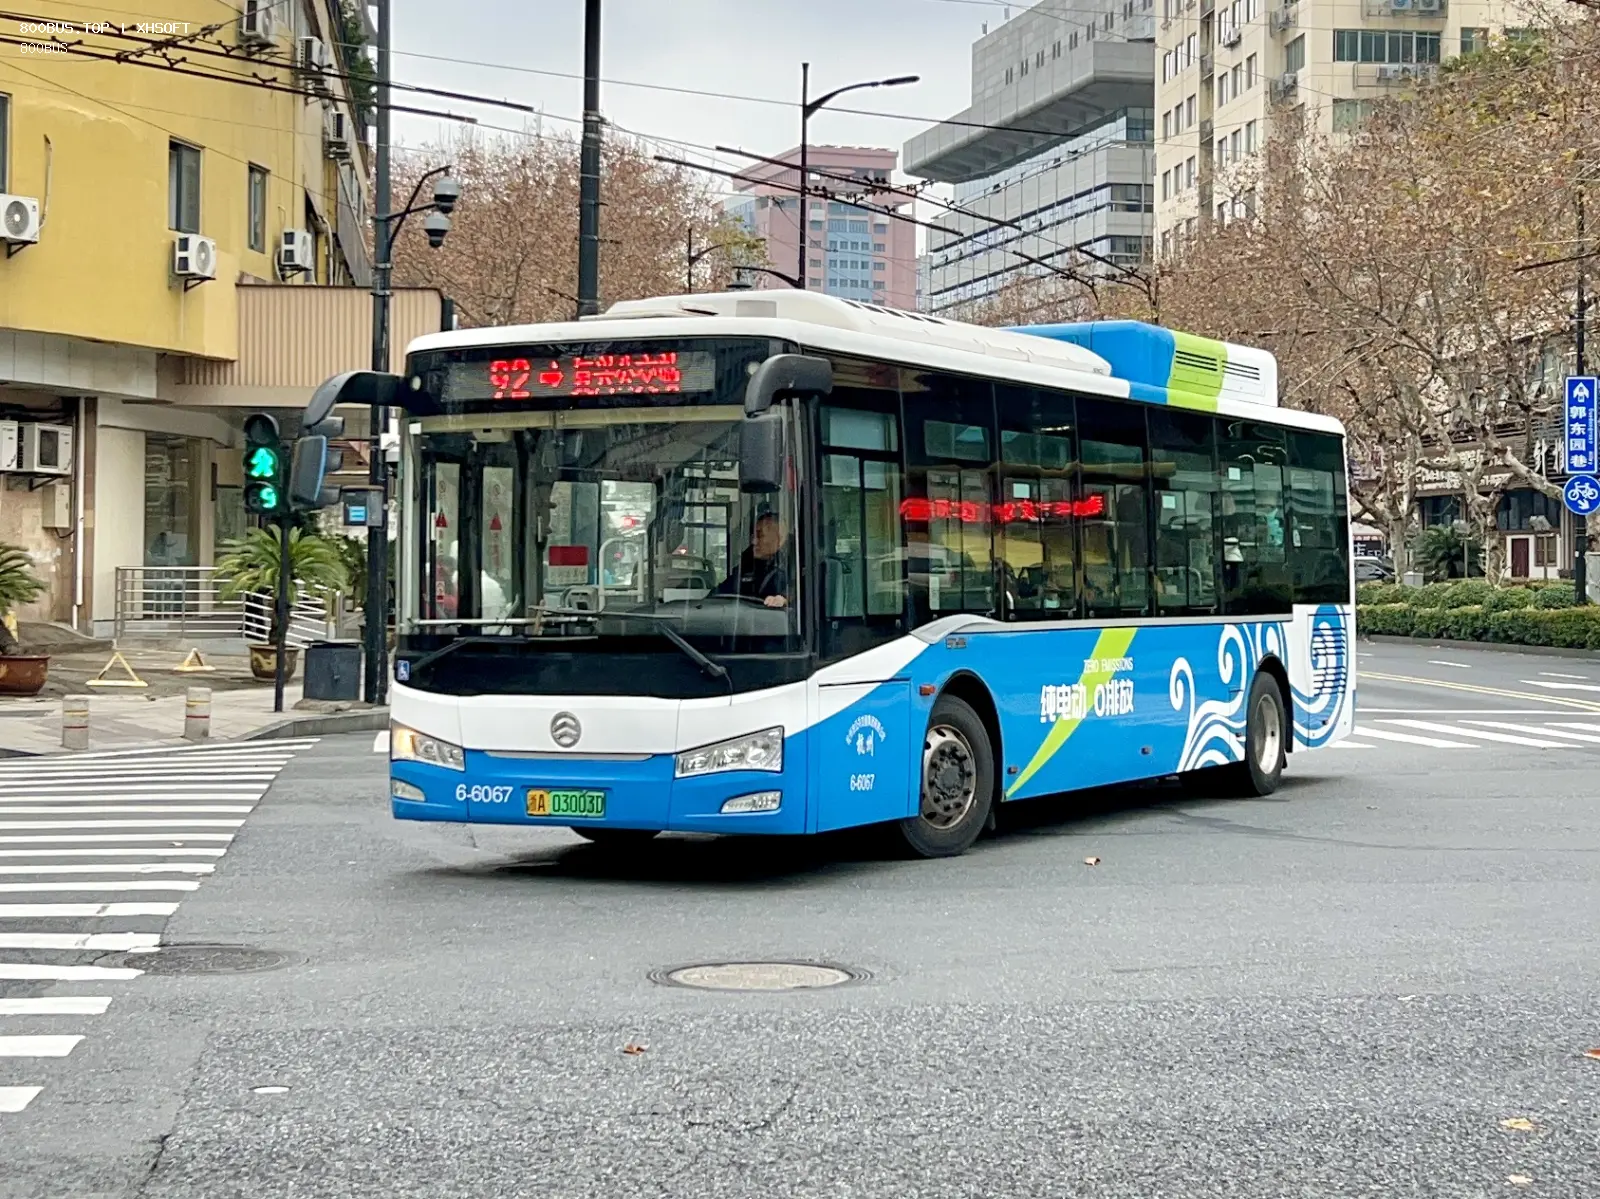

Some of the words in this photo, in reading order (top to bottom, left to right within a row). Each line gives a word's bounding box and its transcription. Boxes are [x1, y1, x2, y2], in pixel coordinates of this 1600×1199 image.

[1569, 405, 1588, 468] 郭东园巷
[1040, 682, 1087, 723] 纯电动
[455, 783, 514, 803] 6-6067
[850, 773, 875, 791] 6-6067
